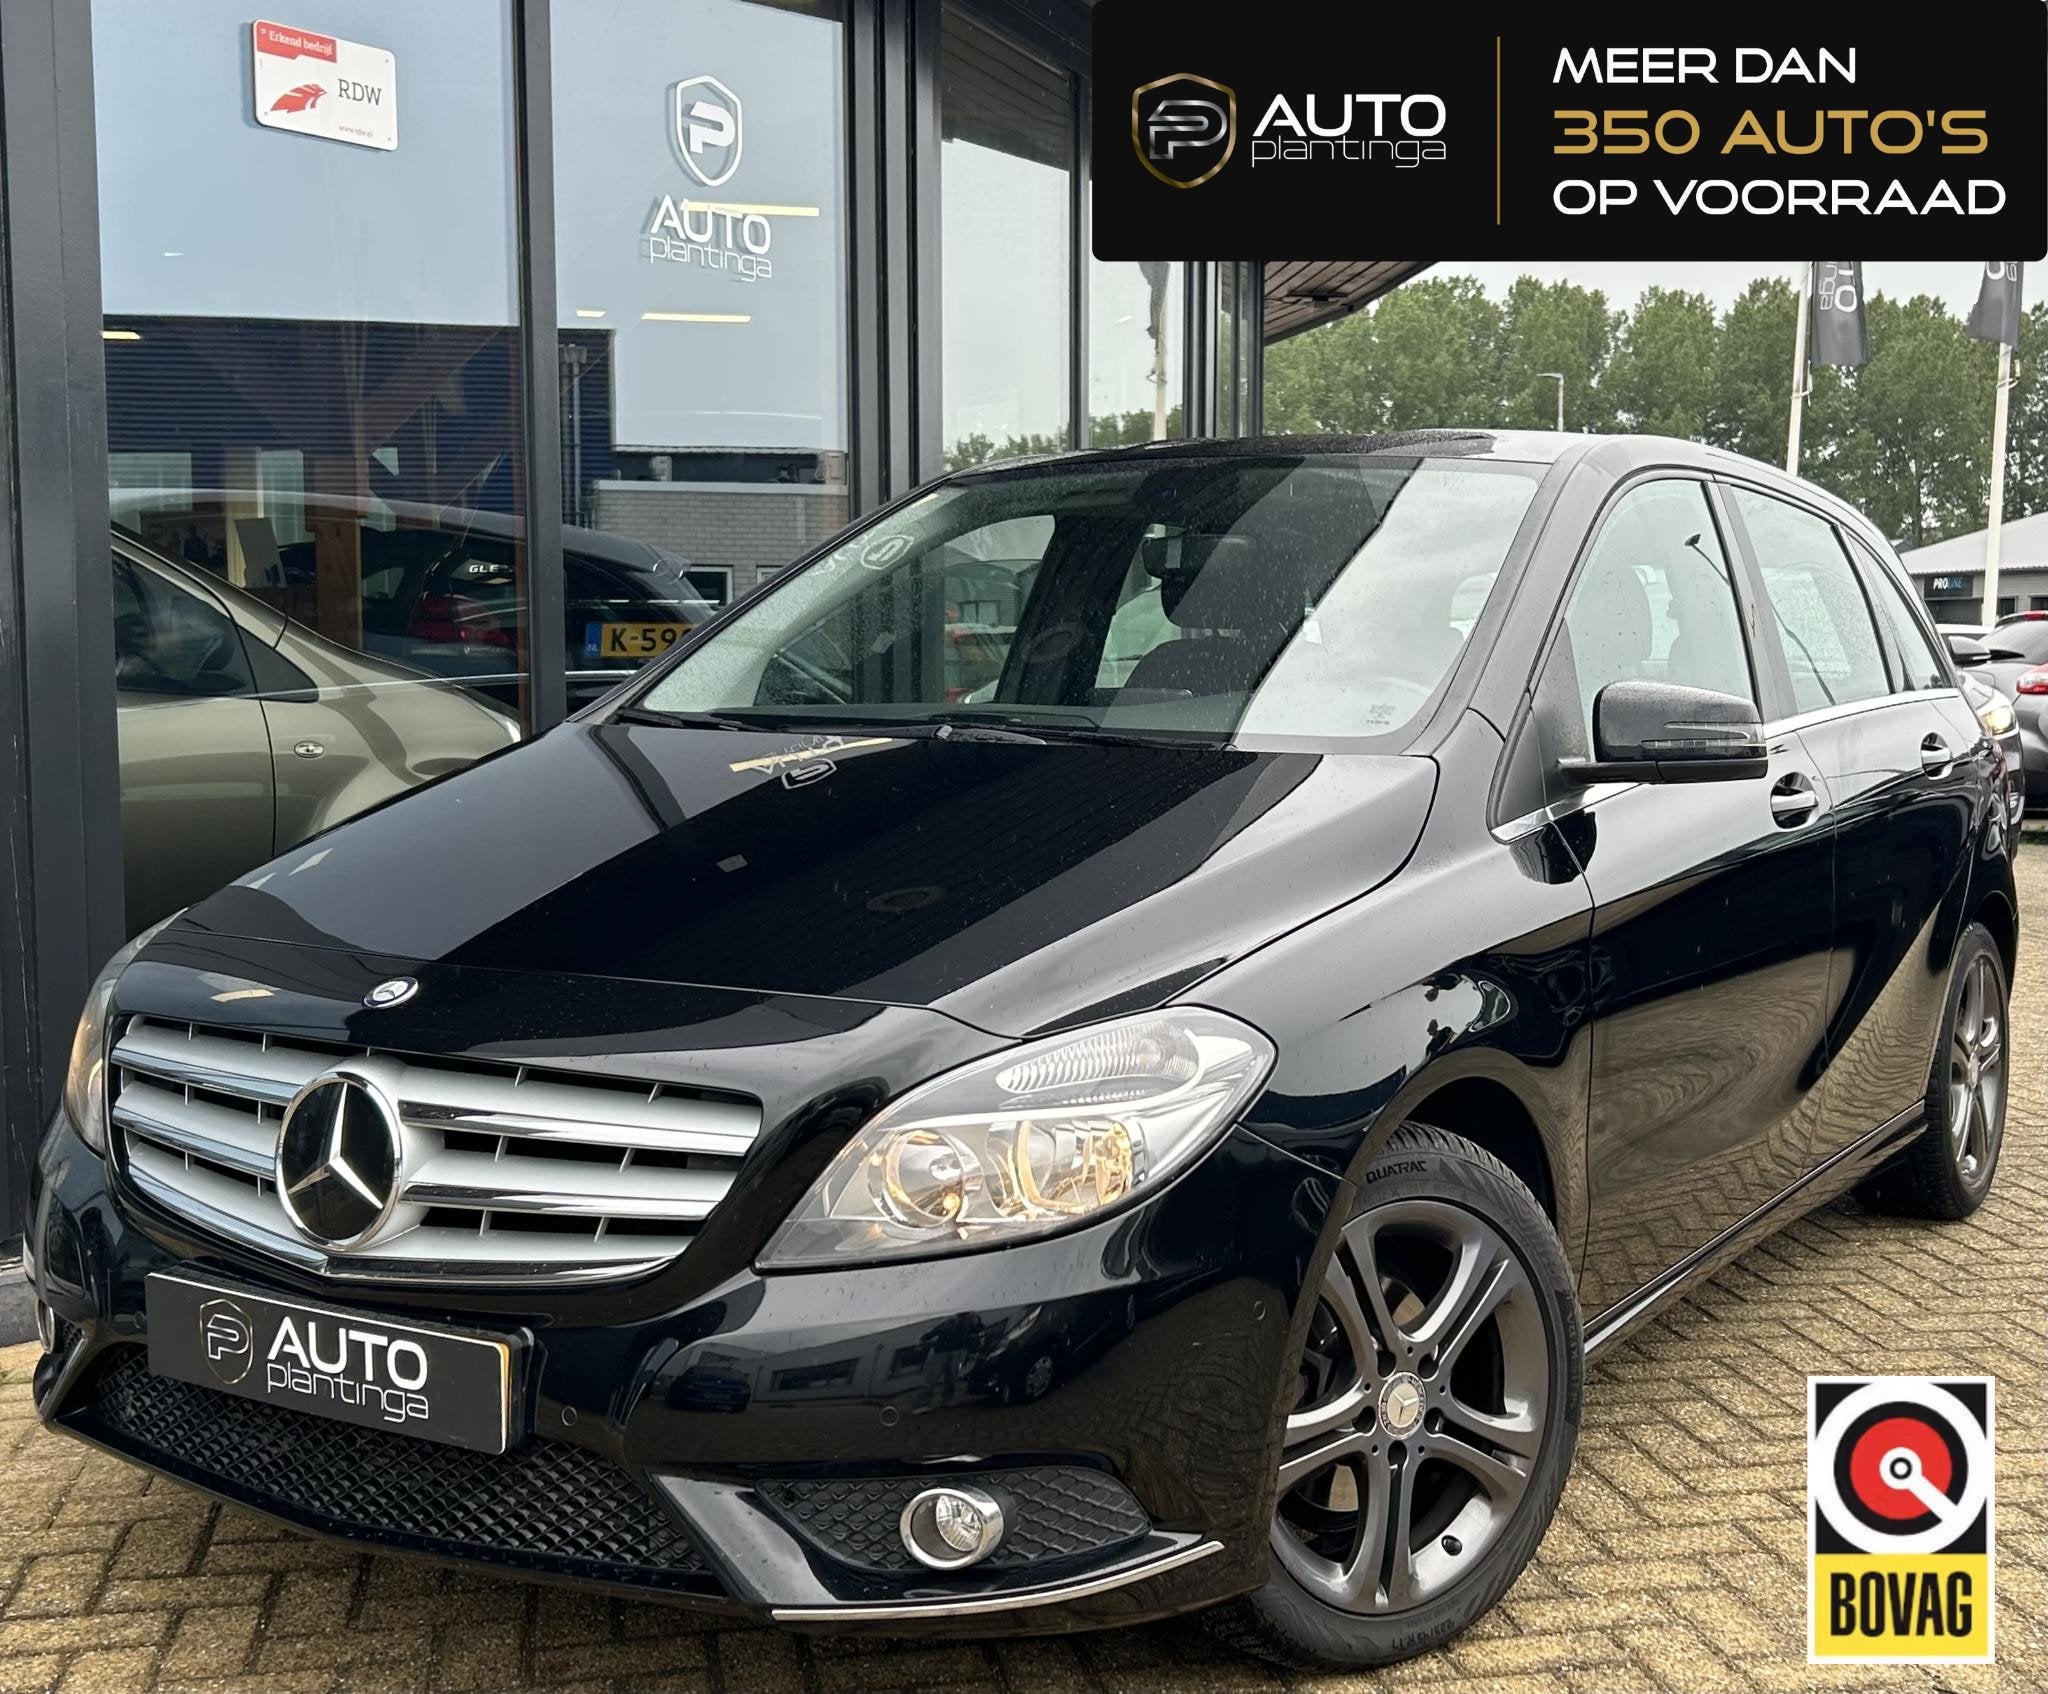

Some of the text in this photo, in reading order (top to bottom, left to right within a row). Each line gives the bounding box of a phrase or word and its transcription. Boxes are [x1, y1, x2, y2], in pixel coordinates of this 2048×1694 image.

[268, 30, 333, 56] Erkend bedrijf
[338, 78, 383, 106] RDW
[650, 194, 771, 255] AUTO
[650, 235, 772, 283] plantinga
[469, 564, 500, 573] GLE
[587, 643, 599, 652] NL
[610, 628, 692, 652] K-59
[1366, 1160, 1428, 1185] QUATRAC
[267, 1315, 429, 1391] AUTO
[266, 1360, 430, 1424] plantinga
